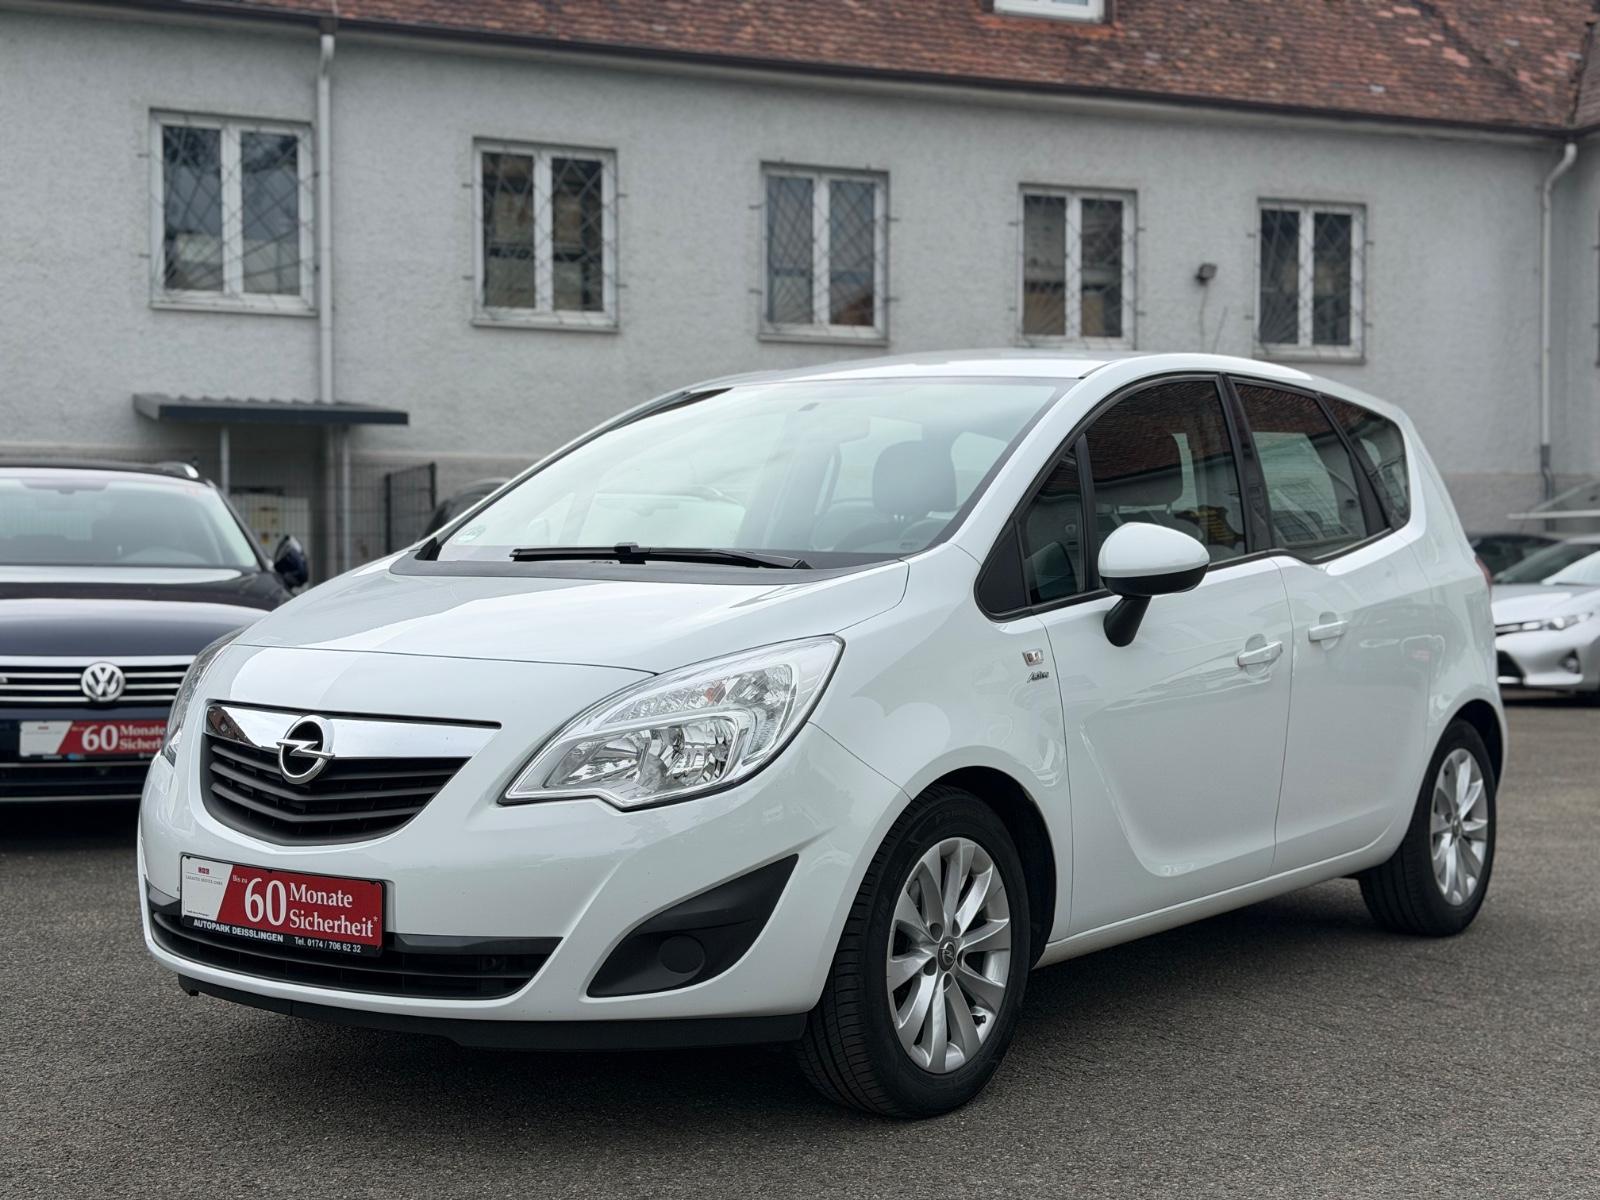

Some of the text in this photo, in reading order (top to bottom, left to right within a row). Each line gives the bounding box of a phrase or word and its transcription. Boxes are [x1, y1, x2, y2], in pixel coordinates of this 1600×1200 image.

[81, 724, 118, 751] 60
[120, 725, 166, 736] Monate
[120, 738, 162, 750] Sicher
[245, 877, 287, 926] 60
[289, 882, 353, 908] Monate
[193, 918, 284, 943] AUTOPARK DEISSLINGEN
[294, 936, 306, 946] Tel.
[307, 938, 324, 949] 0174
[328, 941, 342, 951] 706
[342, 943, 352, 952] 62
[352, 944, 362, 953] 32
